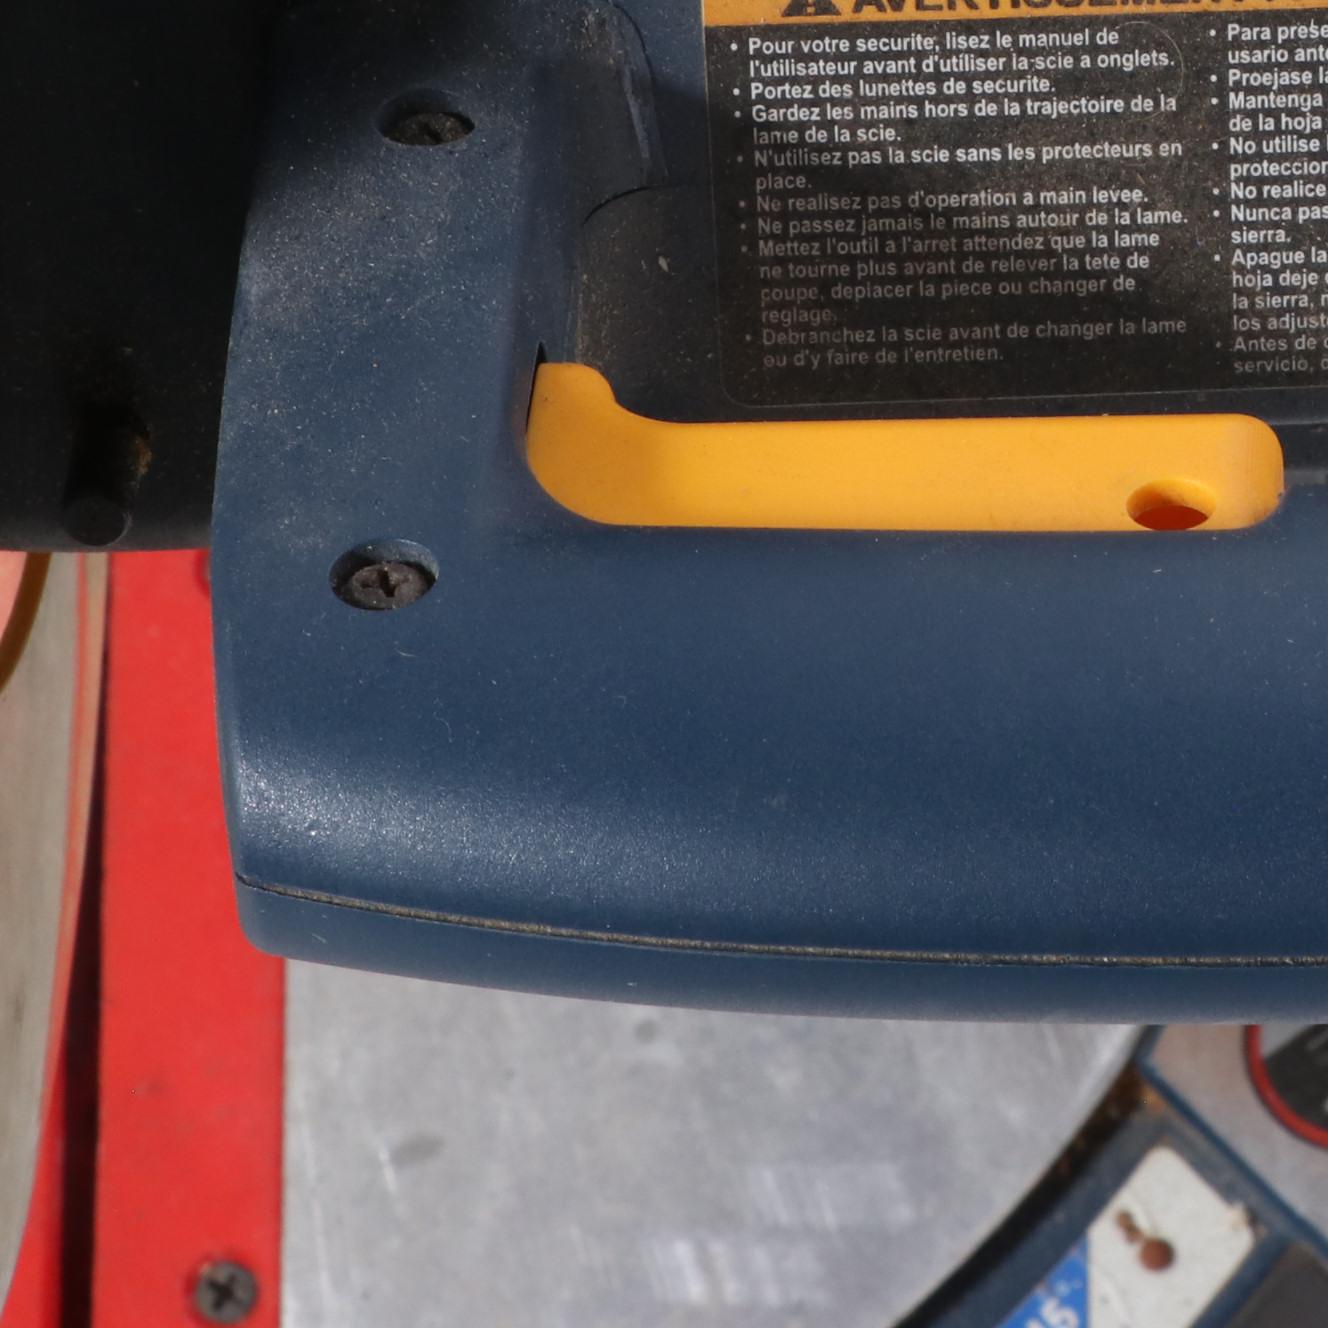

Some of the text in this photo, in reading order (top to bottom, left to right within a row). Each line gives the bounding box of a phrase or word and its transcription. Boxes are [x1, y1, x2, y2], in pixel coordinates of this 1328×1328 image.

[748, 36, 795, 56] Pour
[799, 36, 850, 54] votre
[945, 30, 990, 49] lisez
[995, 29, 1012, 48] le
[1018, 27, 1089, 47] manuel
[1095, 26, 1119, 44] de
[1227, 22, 1270, 41] Para
[749, 57, 858, 79] l'utilisateur
[862, 57, 916, 75] avant
[921, 53, 1006, 73] d'utiliser
[1011, 52, 1028, 70] la
[1034, 50, 1073, 69] scie
[1096, 47, 1175, 71] onglets.
[1227, 45, 1288, 65] usario
[750, 81, 814, 100] Portez
[817, 80, 853, 98] des
[859, 78, 936, 97] lunettes
[942, 77, 966, 95] de
[1227, 67, 1312, 90] Proejase
[751, 93, 1176, 123] Gardez les mains hors de la trajectoire de la
[752, 123, 901, 146] lame de la scie.
